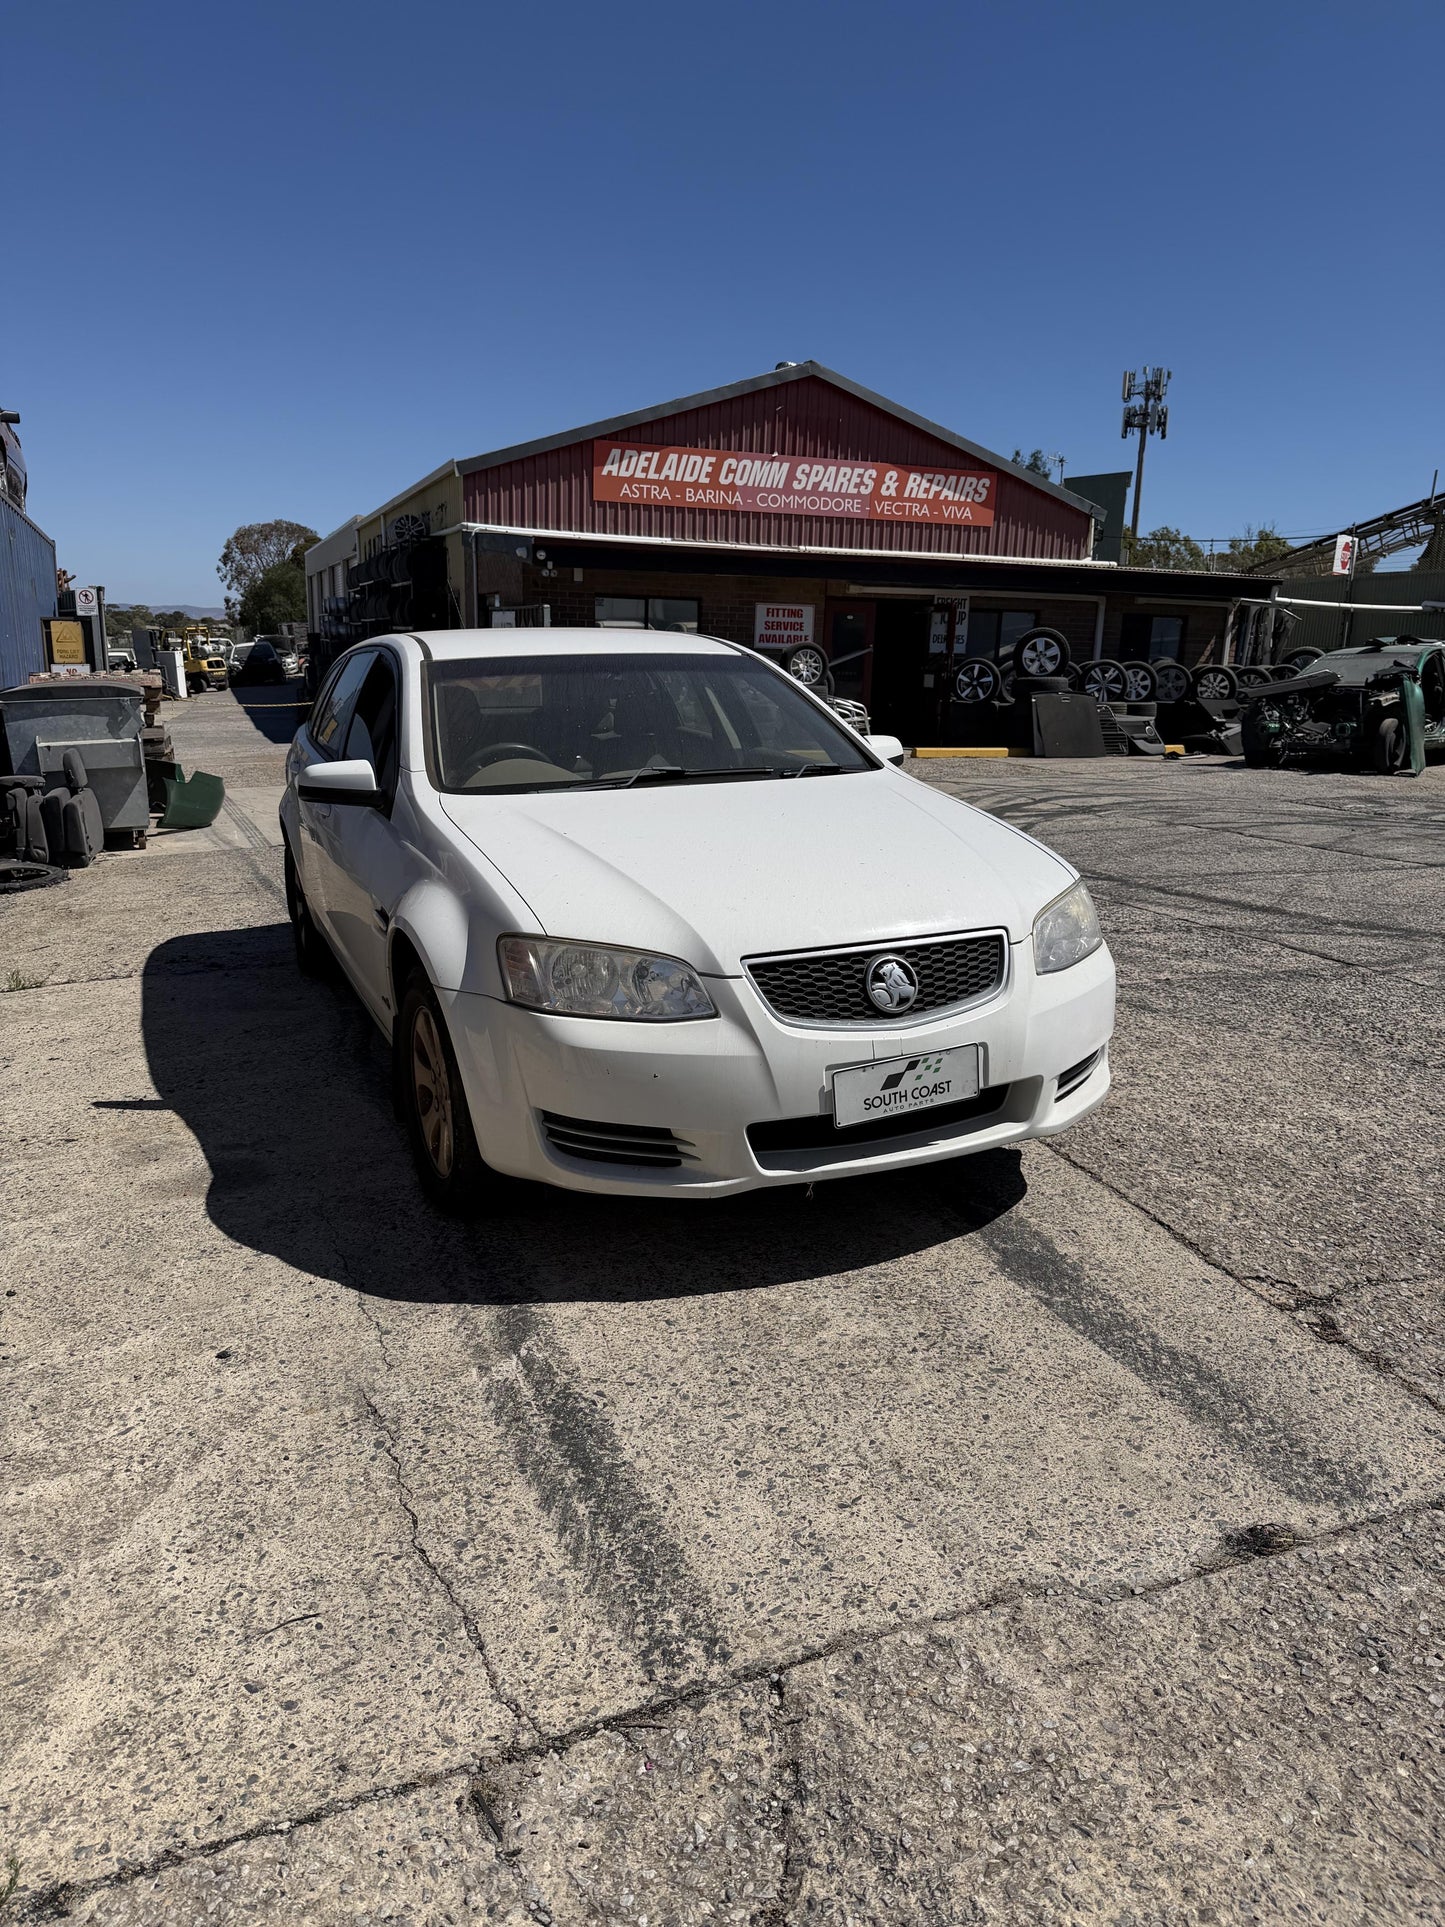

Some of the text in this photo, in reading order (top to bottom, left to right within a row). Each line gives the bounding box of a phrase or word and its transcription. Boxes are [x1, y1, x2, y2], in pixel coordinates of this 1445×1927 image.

[601, 448, 991, 503] ADELAIDE COMM SPARES & REPAIRS
[619, 482, 672, 501] ASTRA
[685, 487, 743, 506] BARINA
[756, 492, 862, 513] COMMODORE
[874, 501, 931, 518] VECTRA
[941, 505, 973, 520] VIVA
[766, 607, 803, 619] FITTING
[764, 621, 804, 632] SERVICE
[863, 1080, 952, 1111] SOUTH COAST
[883, 1098, 935, 1113] AUTO PARTS
